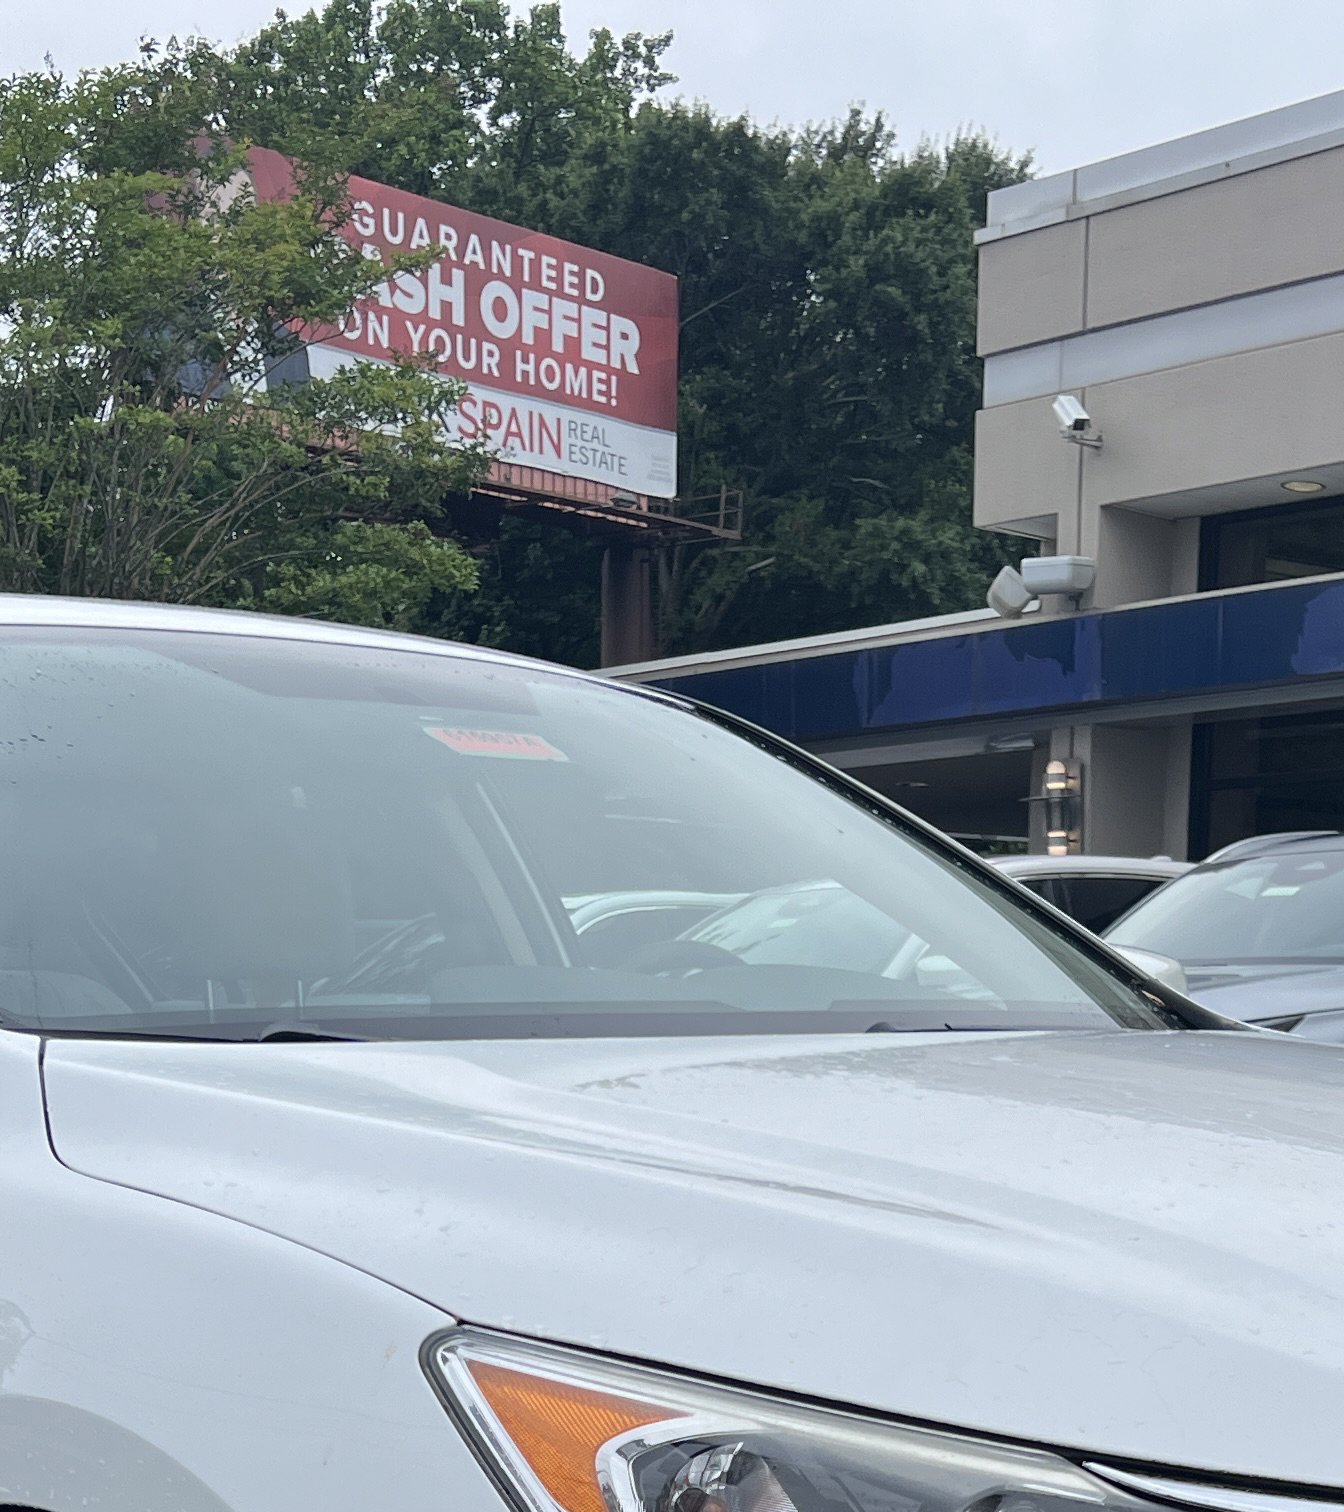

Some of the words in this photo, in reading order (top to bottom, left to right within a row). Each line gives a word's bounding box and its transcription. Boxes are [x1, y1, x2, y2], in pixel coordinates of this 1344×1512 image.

[351, 200, 605, 302] GUARANTEED
[338, 306, 390, 349] ON
[405, 320, 501, 378] YOUR
[515, 349, 618, 407] HOME!
[480, 280, 641, 375] OFFER
[457, 393, 565, 460] SPAIN
[567, 420, 612, 449] REAL
[568, 443, 629, 477] ESTATE
